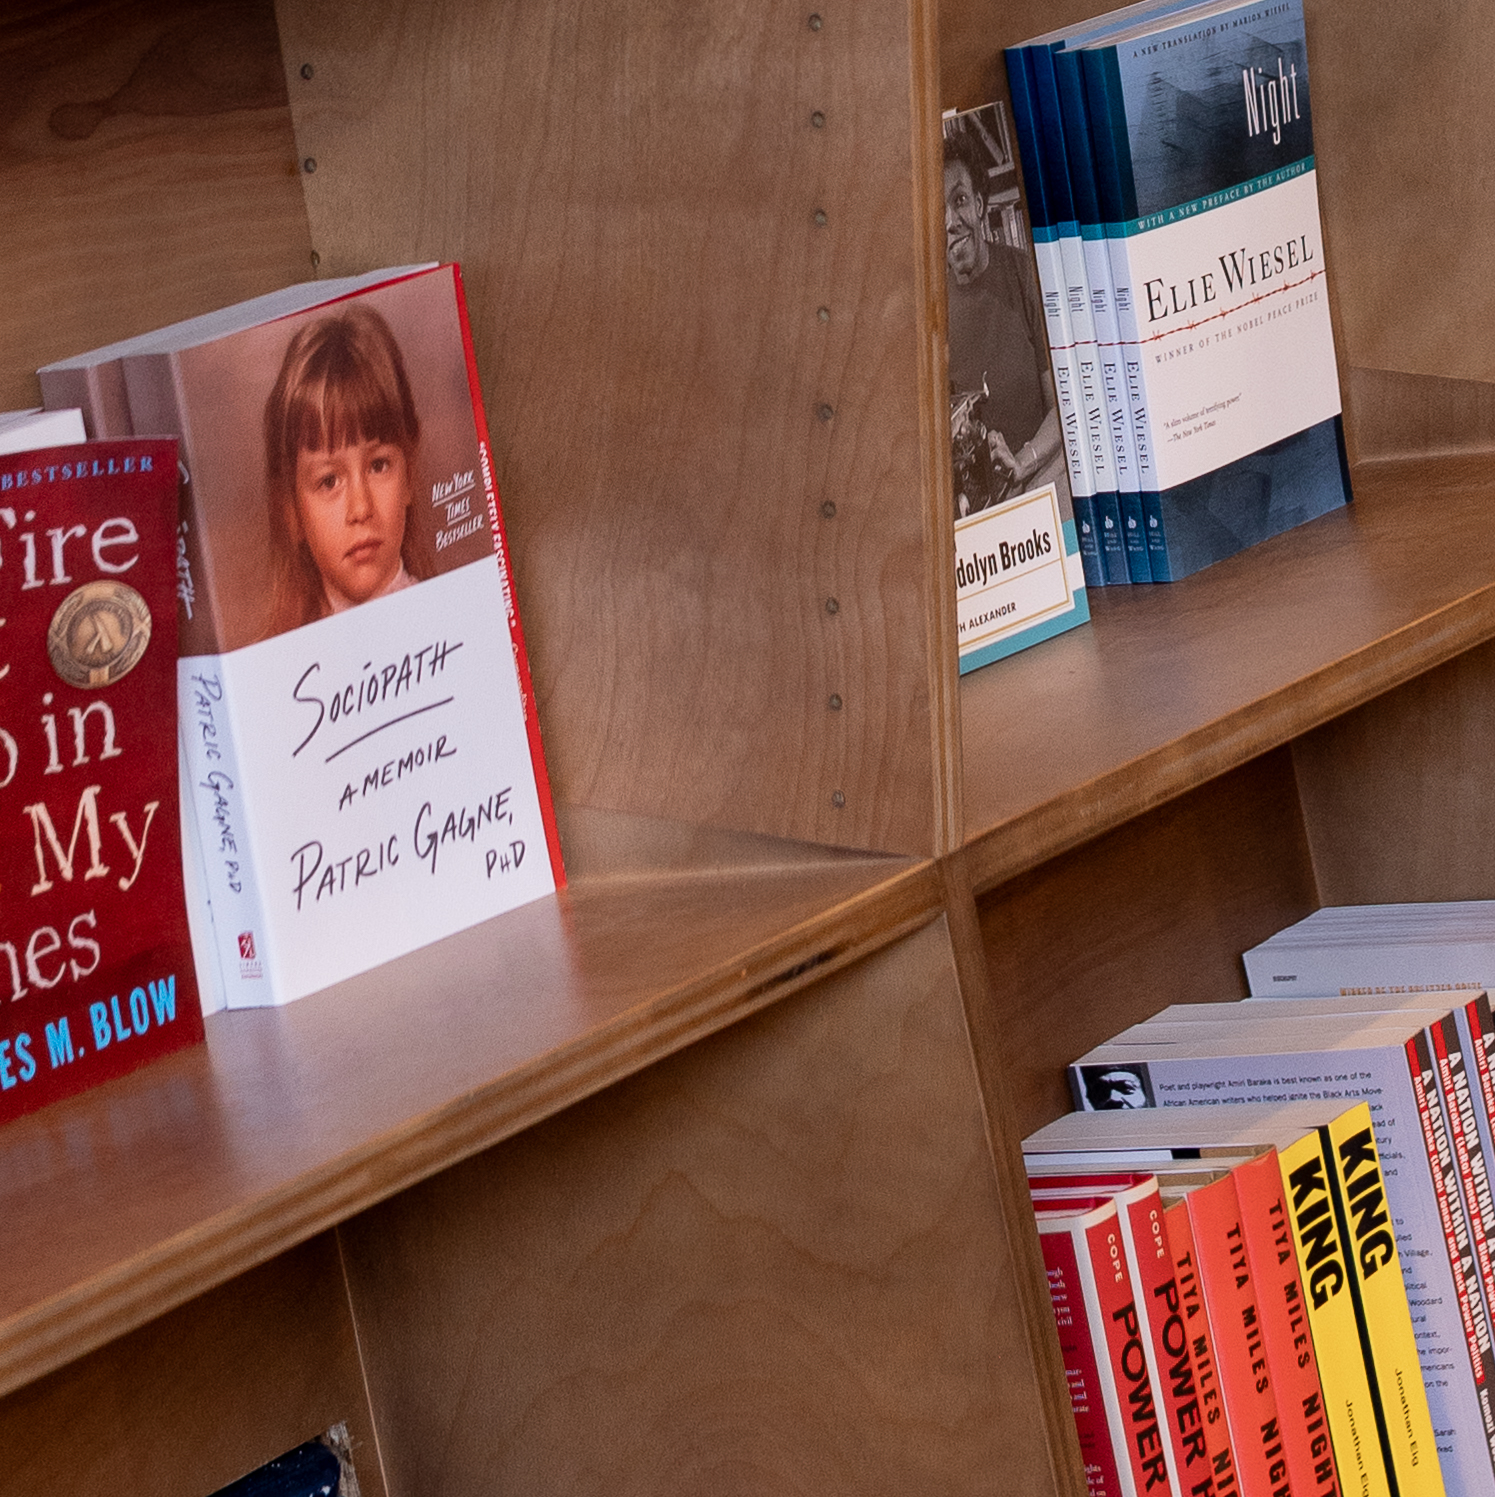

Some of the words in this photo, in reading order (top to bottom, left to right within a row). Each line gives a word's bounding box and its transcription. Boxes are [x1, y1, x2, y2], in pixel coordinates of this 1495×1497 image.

[1242, 56, 1300, 146] Night
[1154, 344, 1194, 365] WINNER
[1198, 337, 1211, 349] OF
[1214, 328, 1233, 344] THE
[1236, 315, 1264, 337] NOBEL
[1267, 303, 1293, 326] PEACE
[1295, 291, 1319, 314] PRIZE
[999, 526, 1054, 573] Brooks
[41, 691, 122, 775] in
[22, 799, 161, 898] My
[291, 835, 400, 912] PATRIC
[48, 1014, 88, 1071] M.
[93, 974, 180, 1054] BLOW
[1288, 1163, 1346, 1313] KING
[1224, 1221, 1251, 1290] TIYA
[1241, 1299, 1271, 1396] MILES
